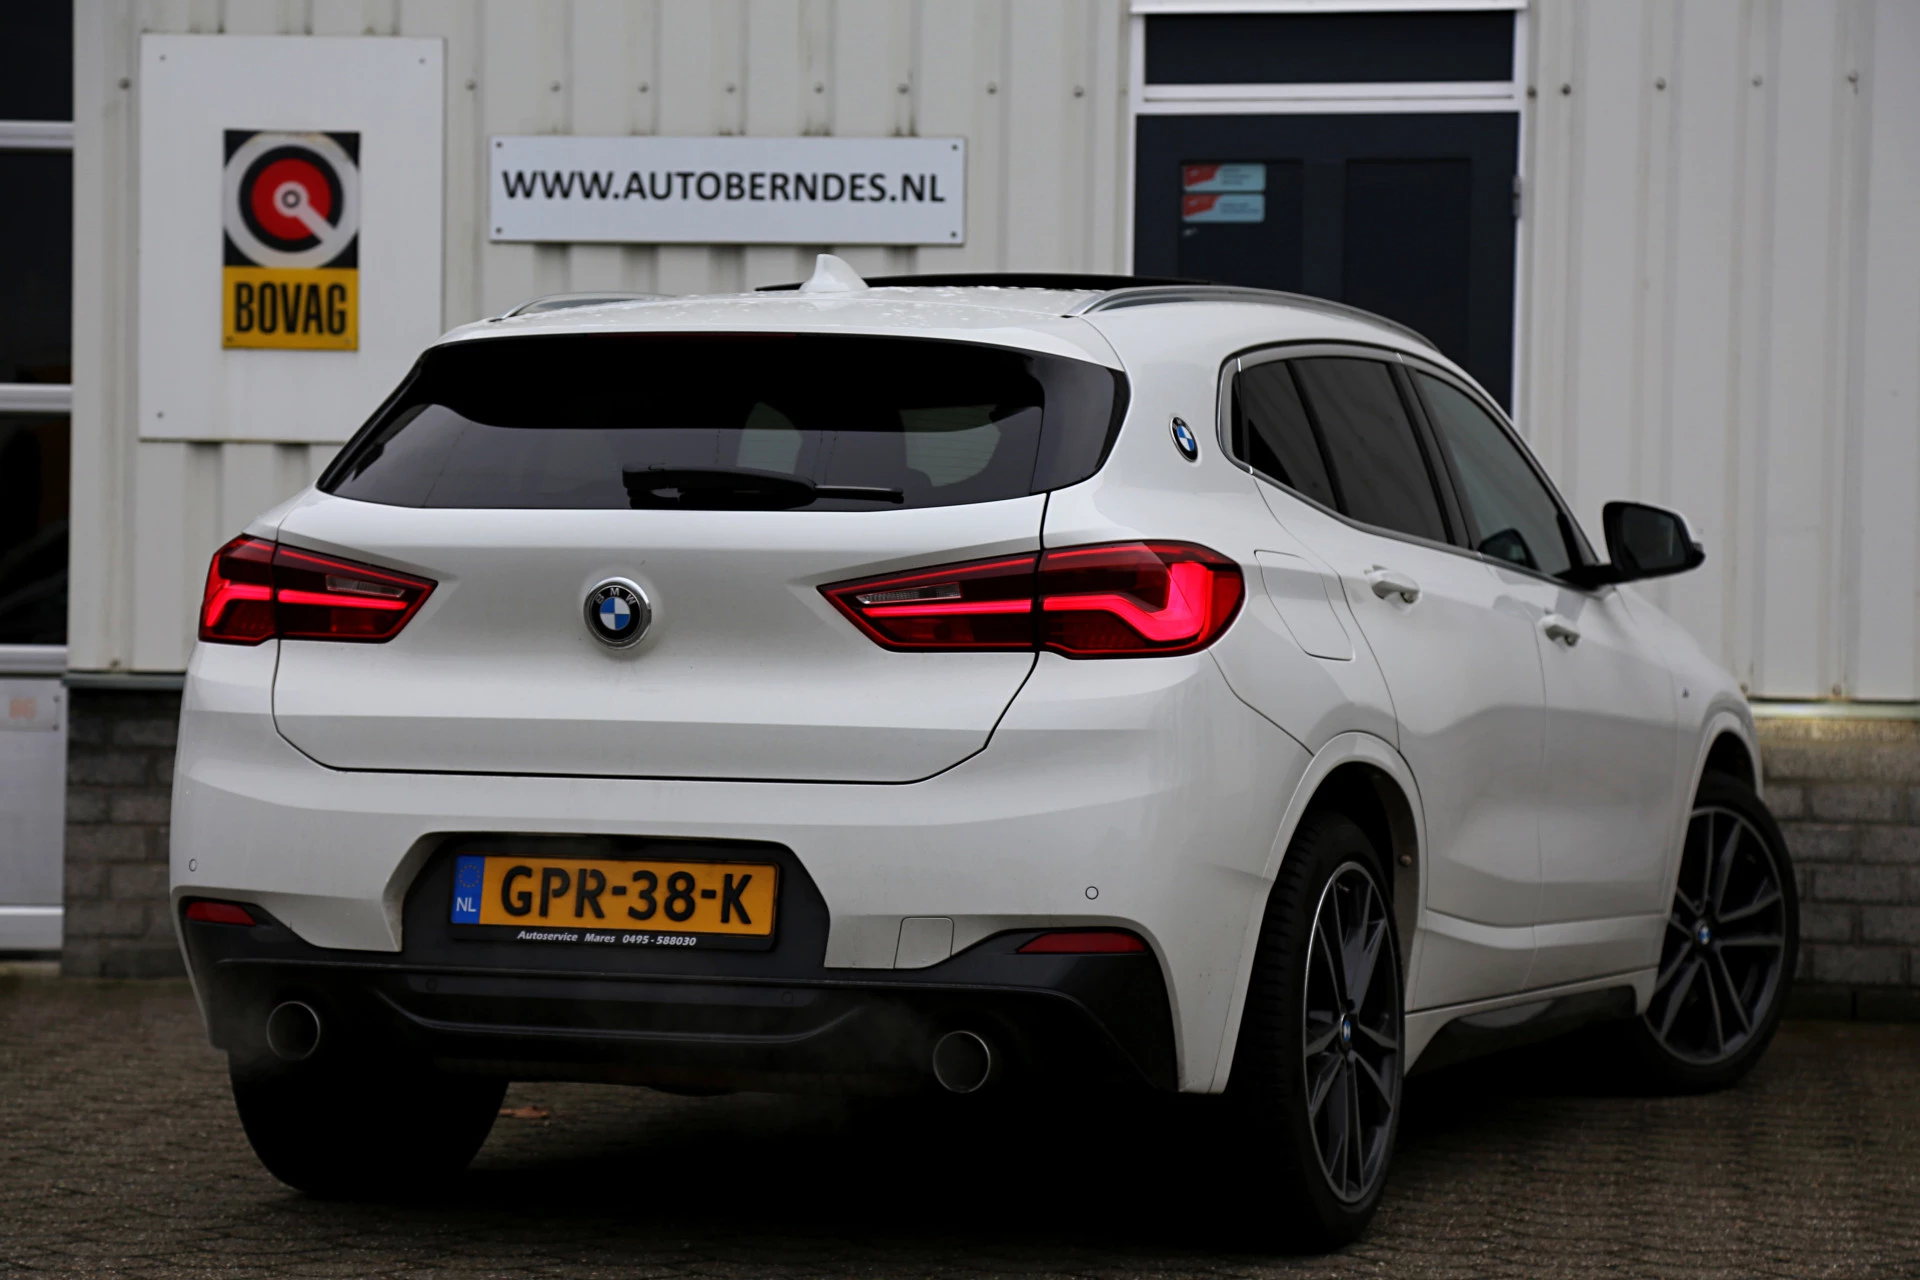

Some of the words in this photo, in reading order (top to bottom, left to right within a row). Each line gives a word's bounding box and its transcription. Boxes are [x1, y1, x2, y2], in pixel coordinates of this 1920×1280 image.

[502, 170, 946, 203] WWW.AUTOBERNDES.NL
[235, 281, 347, 336] BOVAG
[595, 587, 637, 605] BMW
[456, 897, 477, 913] NL
[501, 865, 753, 925] GPR-38-K
[517, 930, 578, 942] Autoservice
[584, 933, 616, 943] Mares
